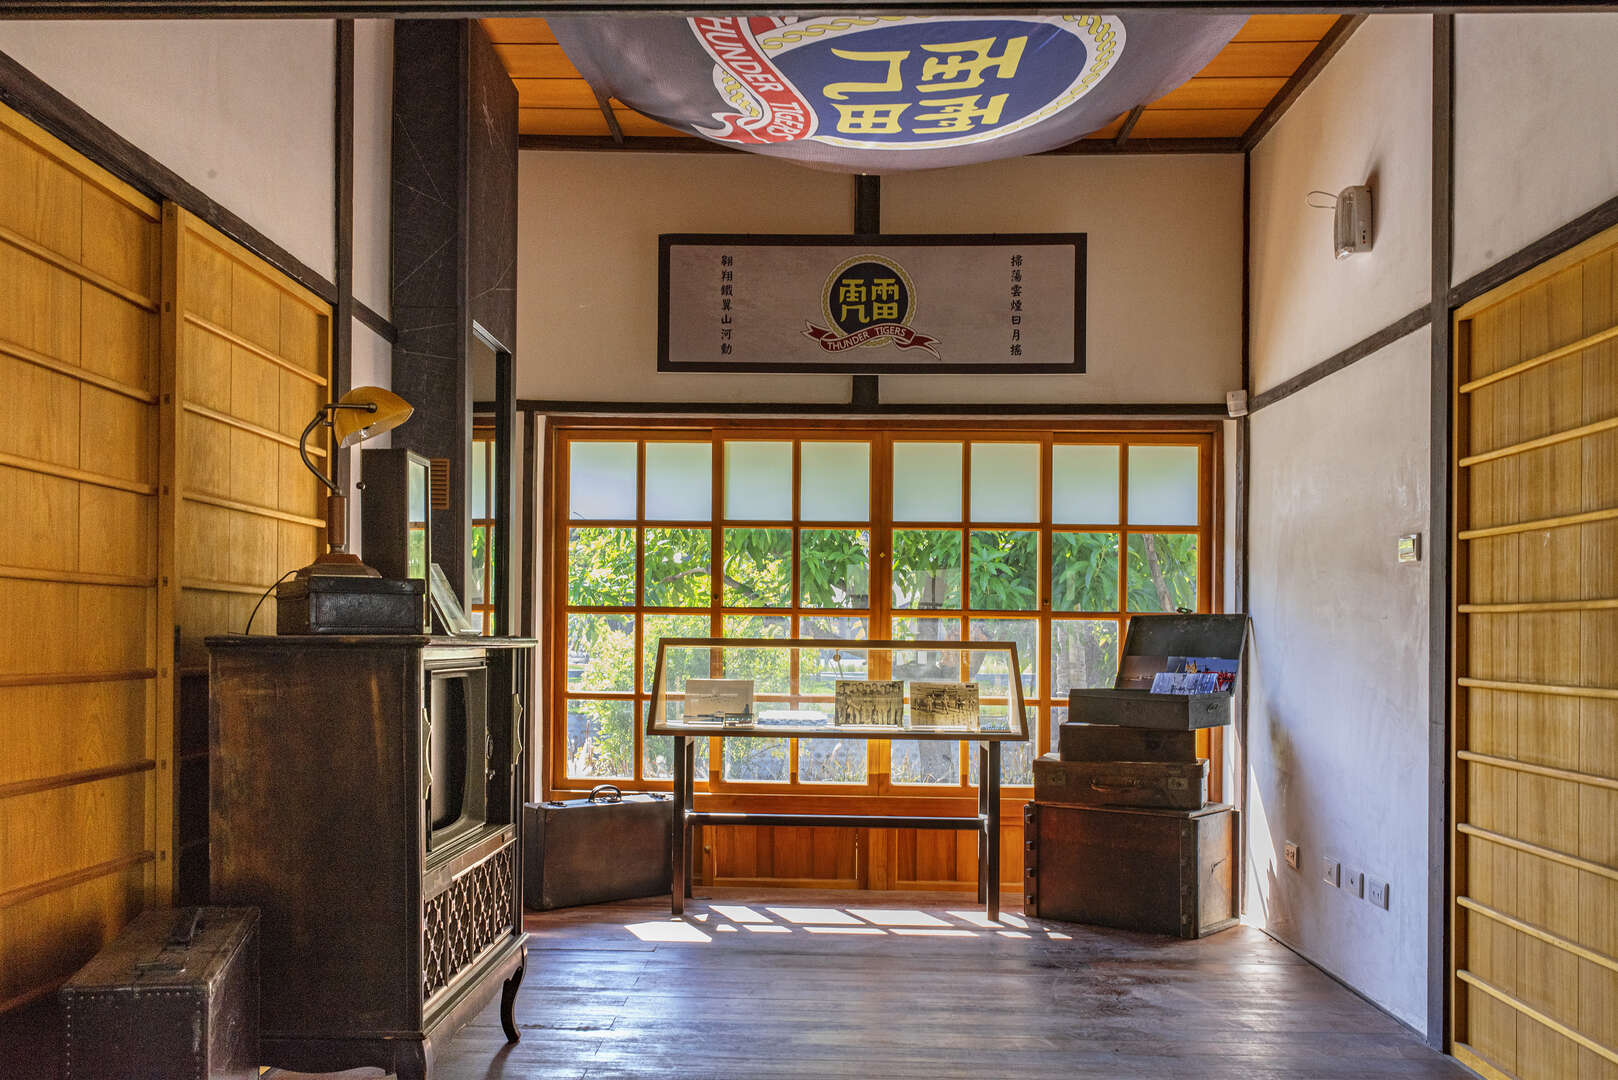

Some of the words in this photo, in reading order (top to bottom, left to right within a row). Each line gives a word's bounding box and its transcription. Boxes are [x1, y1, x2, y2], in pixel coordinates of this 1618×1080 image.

[700, 16, 784, 92] HUNDER
[769, 102, 805, 140] TIGERS
[827, 331, 870, 350] THUNDER
[874, 326, 907, 337] TIGERS
